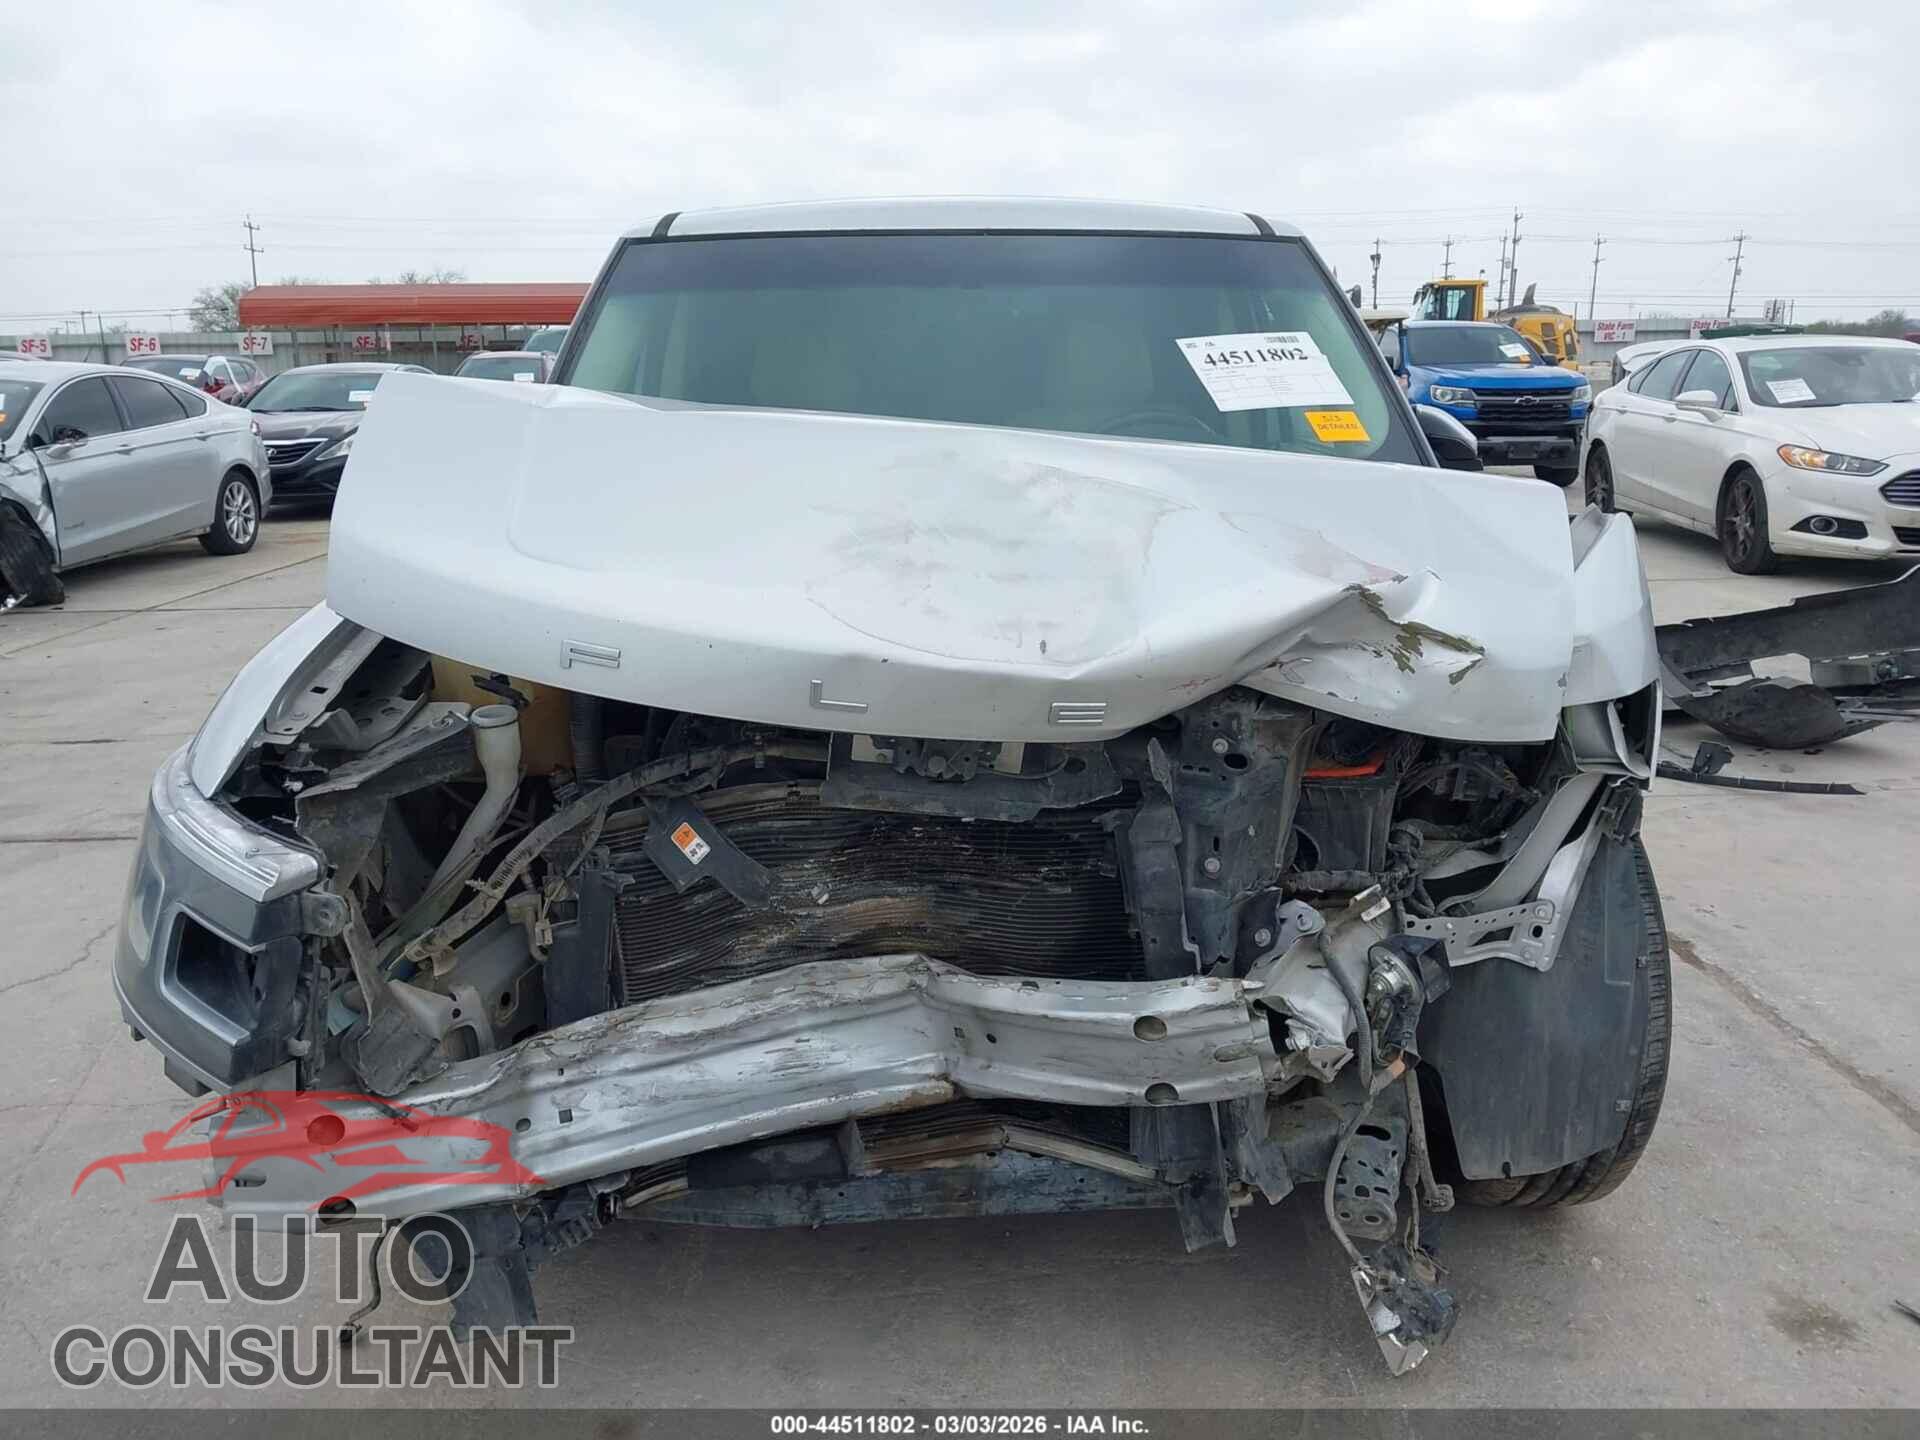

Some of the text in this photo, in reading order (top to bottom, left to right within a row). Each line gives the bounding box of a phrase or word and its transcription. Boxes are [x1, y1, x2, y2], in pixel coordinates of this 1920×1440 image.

[20, 339, 48, 353] SF-5
[130, 337, 156, 351] SF-6
[242, 337, 268, 350] SF-7
[1203, 347, 1309, 367] 44511802
